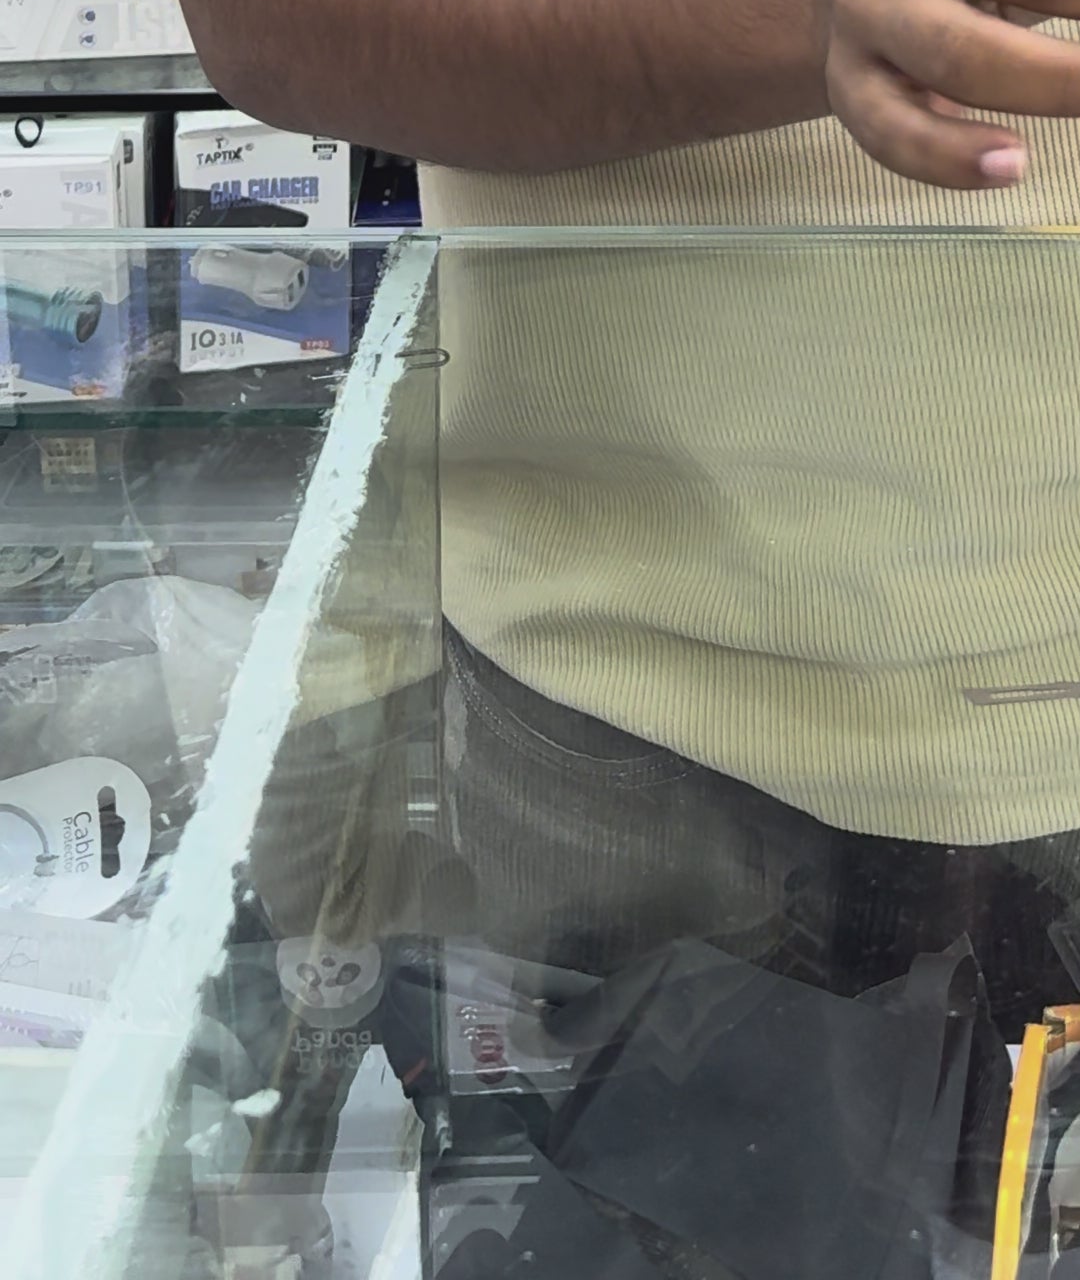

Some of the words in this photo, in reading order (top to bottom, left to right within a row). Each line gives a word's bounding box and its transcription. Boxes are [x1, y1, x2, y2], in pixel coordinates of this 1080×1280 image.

[211, 180, 242, 204] CAR
[248, 176, 319, 199] CHARGER
[62, 817, 73, 874] Protector
[73, 811, 94, 873] Cable
